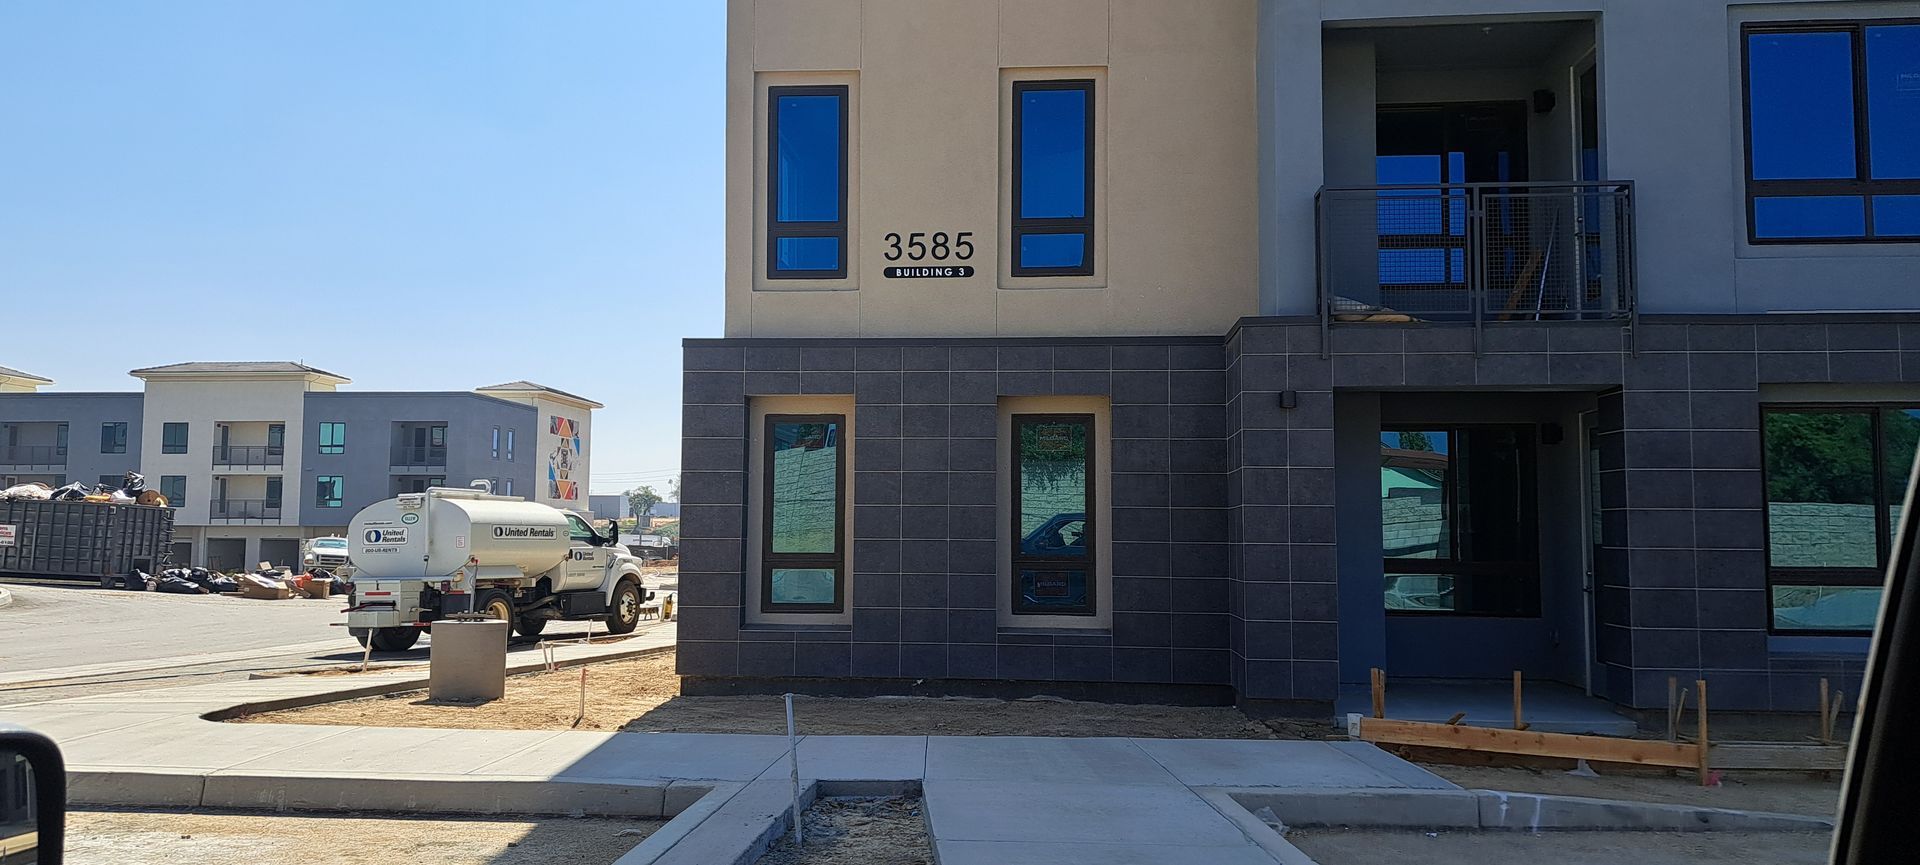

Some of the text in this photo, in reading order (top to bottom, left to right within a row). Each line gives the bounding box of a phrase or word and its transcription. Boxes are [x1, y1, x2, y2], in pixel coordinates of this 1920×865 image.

[884, 232, 974, 261] 3585
[896, 268, 965, 276] BUILDING 3
[505, 527, 554, 537] United Rentals
